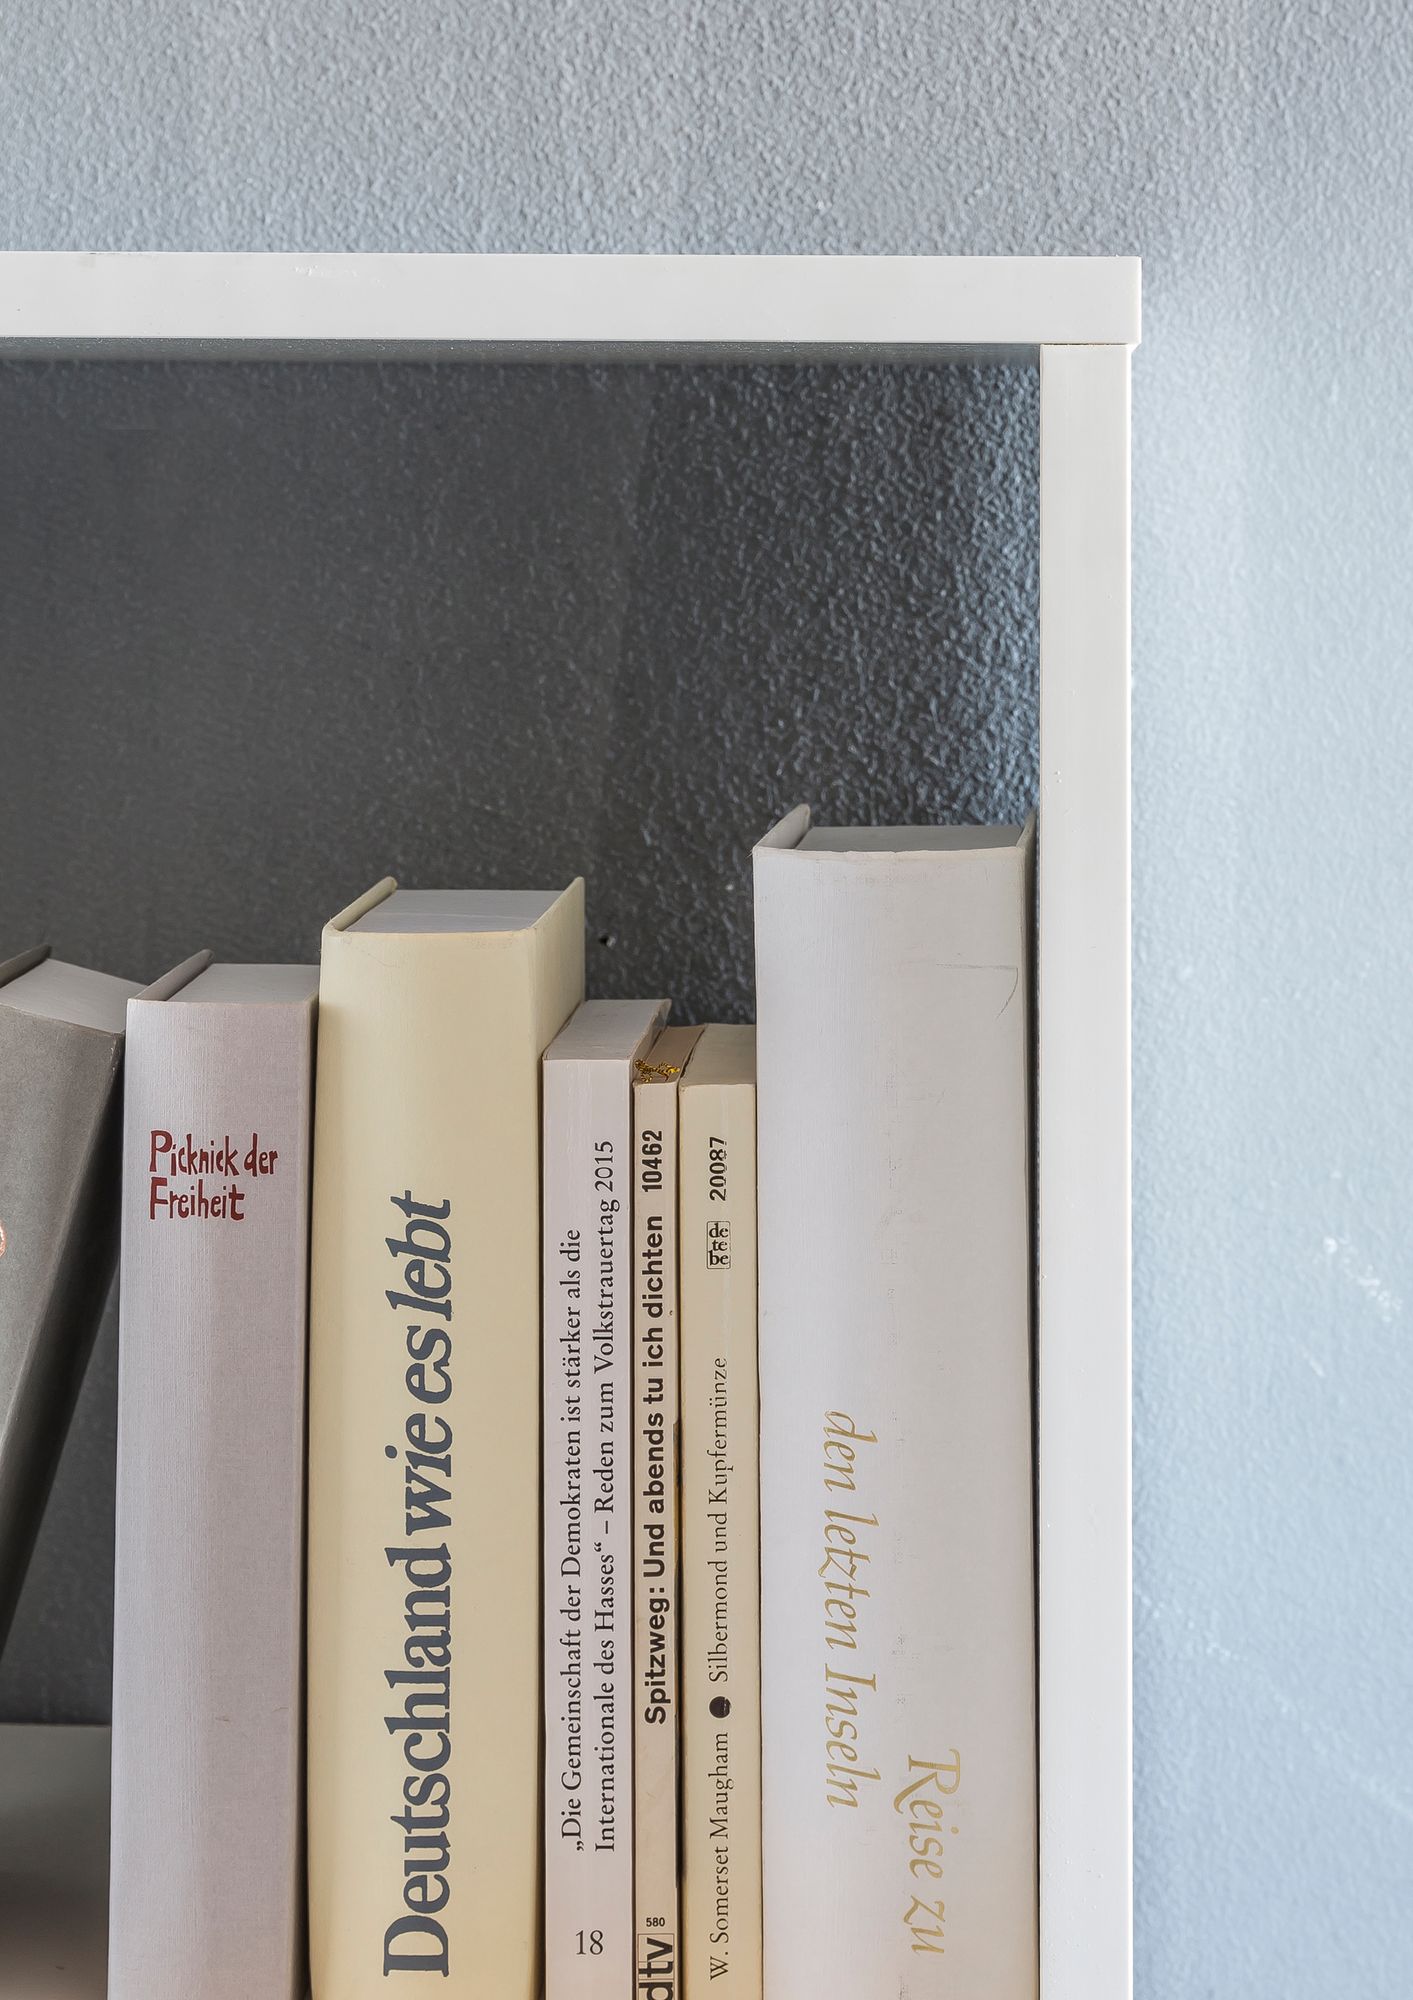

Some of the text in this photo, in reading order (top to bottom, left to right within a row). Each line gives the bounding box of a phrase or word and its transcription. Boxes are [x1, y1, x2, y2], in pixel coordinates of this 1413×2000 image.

[150, 1130, 279, 1177] Picknick der
[594, 1141, 614, 1192] 2015
[641, 1130, 663, 1192] 10462
[708, 1137, 728, 1201] 20087
[150, 1177, 245, 1220] Freiheit
[592, 1199, 620, 1374] Volkstrauertag
[599, 1382, 614, 1432] zum
[593, 1441, 614, 1513] Reden
[642, 1216, 671, 1725] Spitzweg: Und abends tu ich dichten
[559, 1230, 585, 1851] „Die Gemeinschaft der Demokraten ist stärker als die
[706, 1358, 733, 1683] Silbermond und Kupfermünze
[383, 1190, 453, 1977] Deutschland wie es lebt
[593, 1542, 615, 1632] Hasses“
[817, 1411, 882, 1809] den letzten Inseln
[593, 1640, 615, 1674] des
[593, 1683, 615, 1852] Internationale
[708, 1733, 733, 1981] W. Somerset Maugham
[893, 1748, 961, 1955] Reise zu
[576, 1930, 604, 1955] 18
[645, 1917, 666, 1928] 580
[638, 1936, 674, 2000] dtv
